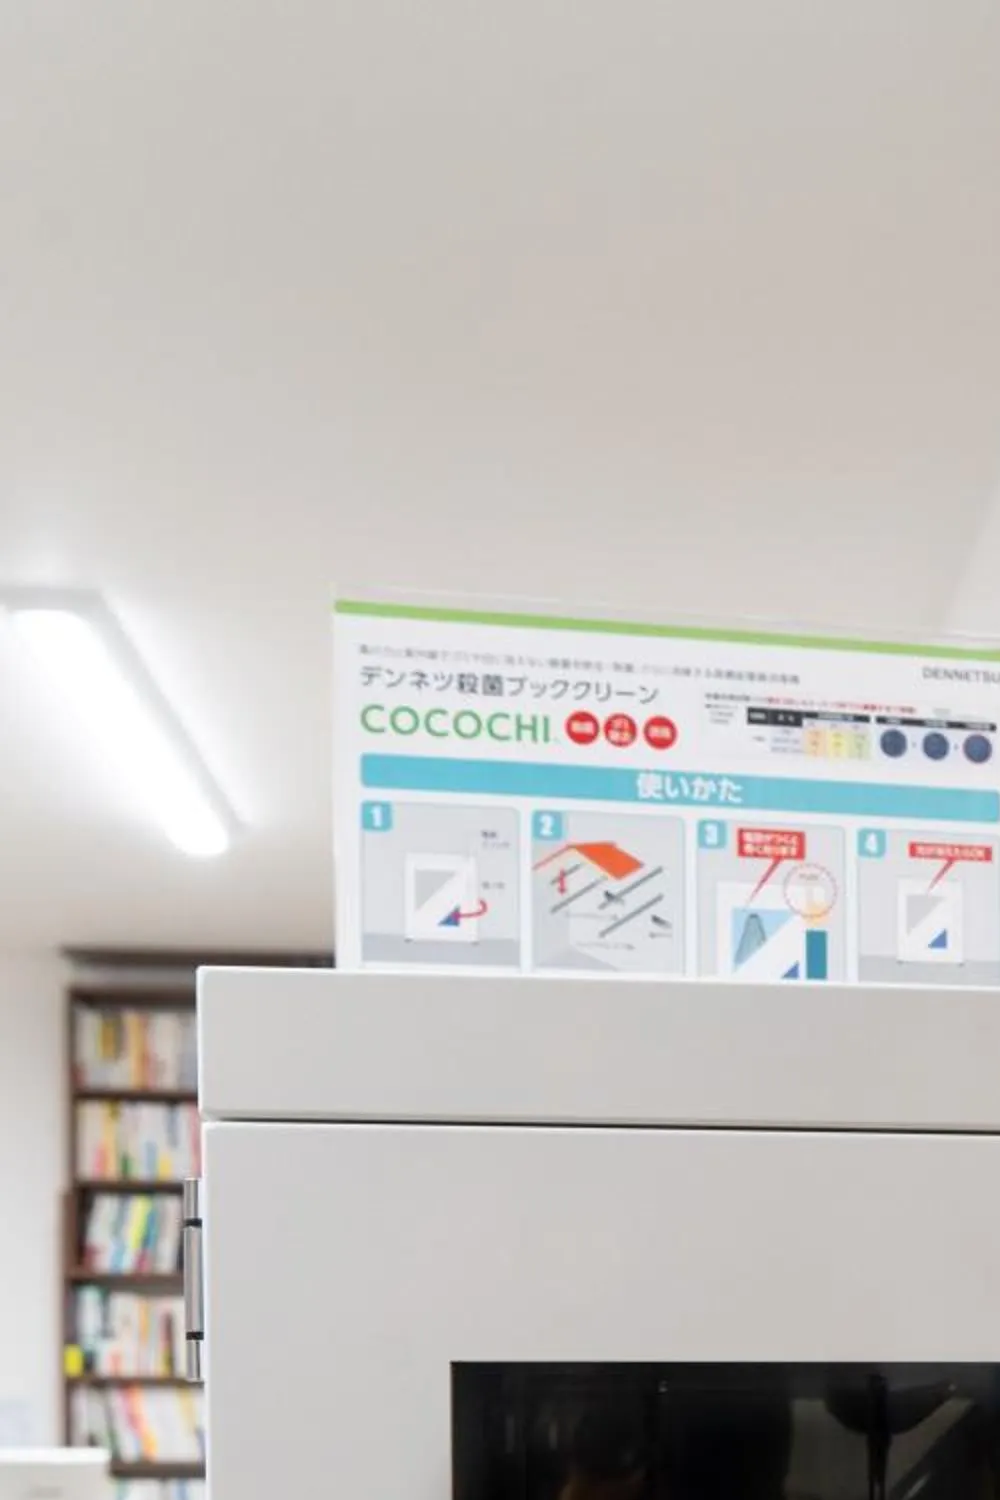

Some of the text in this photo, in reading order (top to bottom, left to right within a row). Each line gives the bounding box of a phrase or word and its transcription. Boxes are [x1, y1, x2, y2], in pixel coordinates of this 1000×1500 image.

[359, 665, 660, 704] デンネツ殺菌ブッククリーン
[360, 704, 551, 744] COCOCHI
[637, 772, 744, 803] 使いかた
[370, 805, 383, 827] 1
[538, 815, 554, 836] 2
[704, 824, 719, 846] 3
[864, 832, 879, 855] 4
